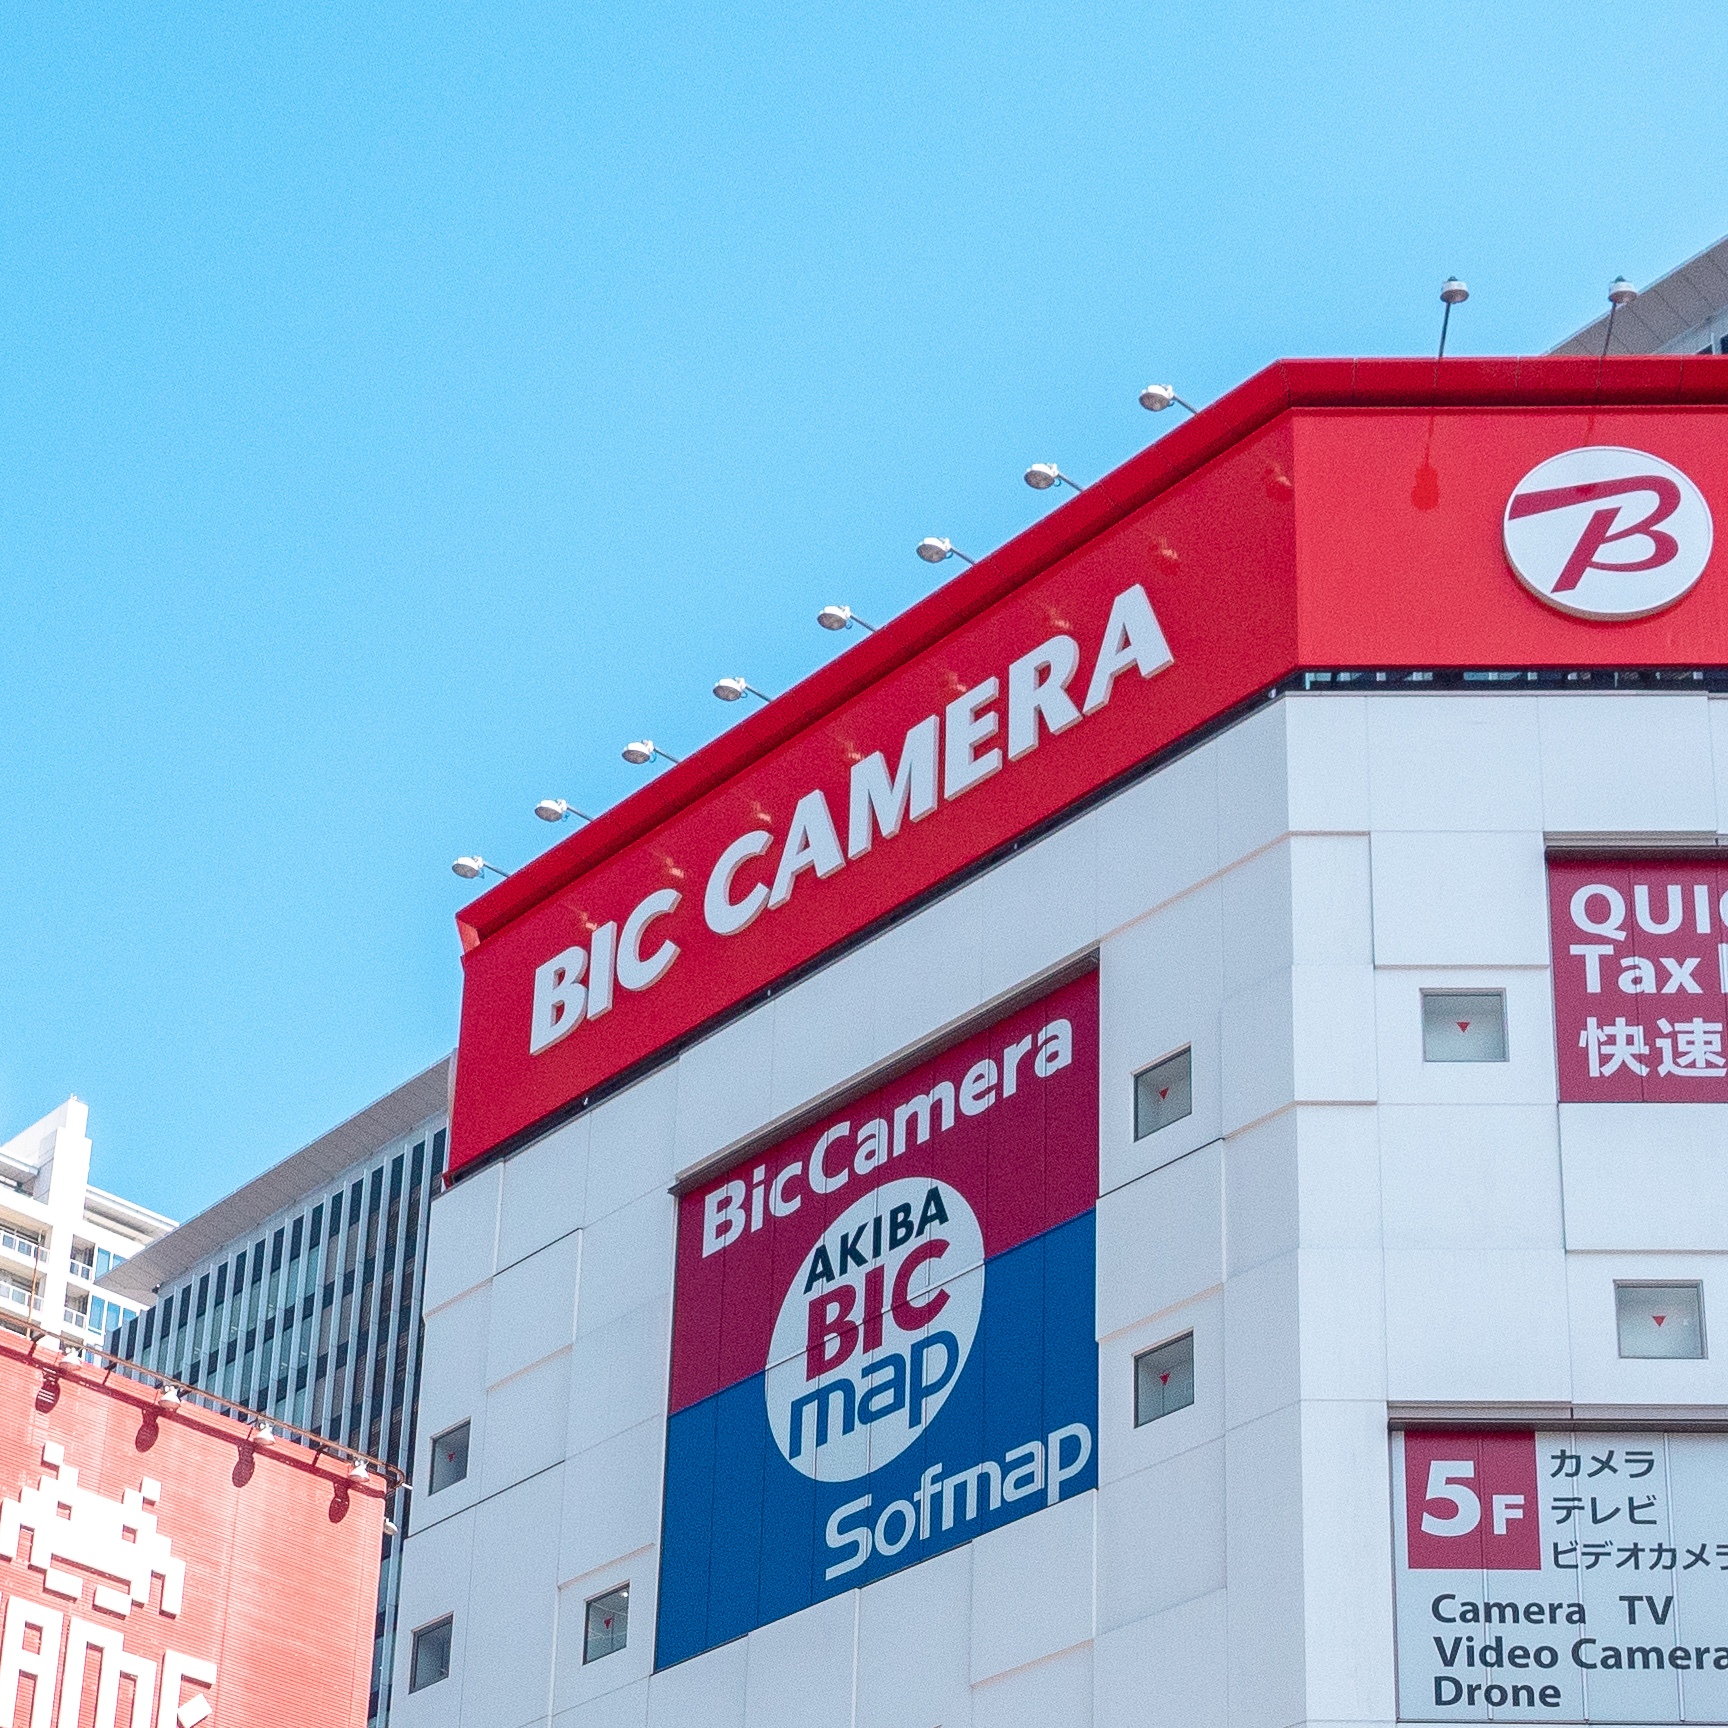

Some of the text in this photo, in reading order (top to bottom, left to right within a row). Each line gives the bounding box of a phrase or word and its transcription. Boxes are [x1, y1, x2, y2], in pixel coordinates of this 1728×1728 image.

[529, 582, 1174, 1056] BIC CAMERA
[1570, 944, 1703, 994] Tax
[702, 1018, 1073, 1258] BicCamera
[803, 1187, 949, 1294] AKIBA
[806, 1239, 951, 1380] BIC
[789, 1330, 959, 1459] map
[824, 1422, 1092, 1580] Sofmap
[1420, 1460, 1525, 1537] 5F
[1550, 1449, 1655, 1478] カメラ
[1551, 1495, 1657, 1525] テレビ
[1431, 1594, 1673, 1625] Camera TV
[1433, 1635, 1559, 1668] Video
[1434, 1676, 1561, 1707] Drone
